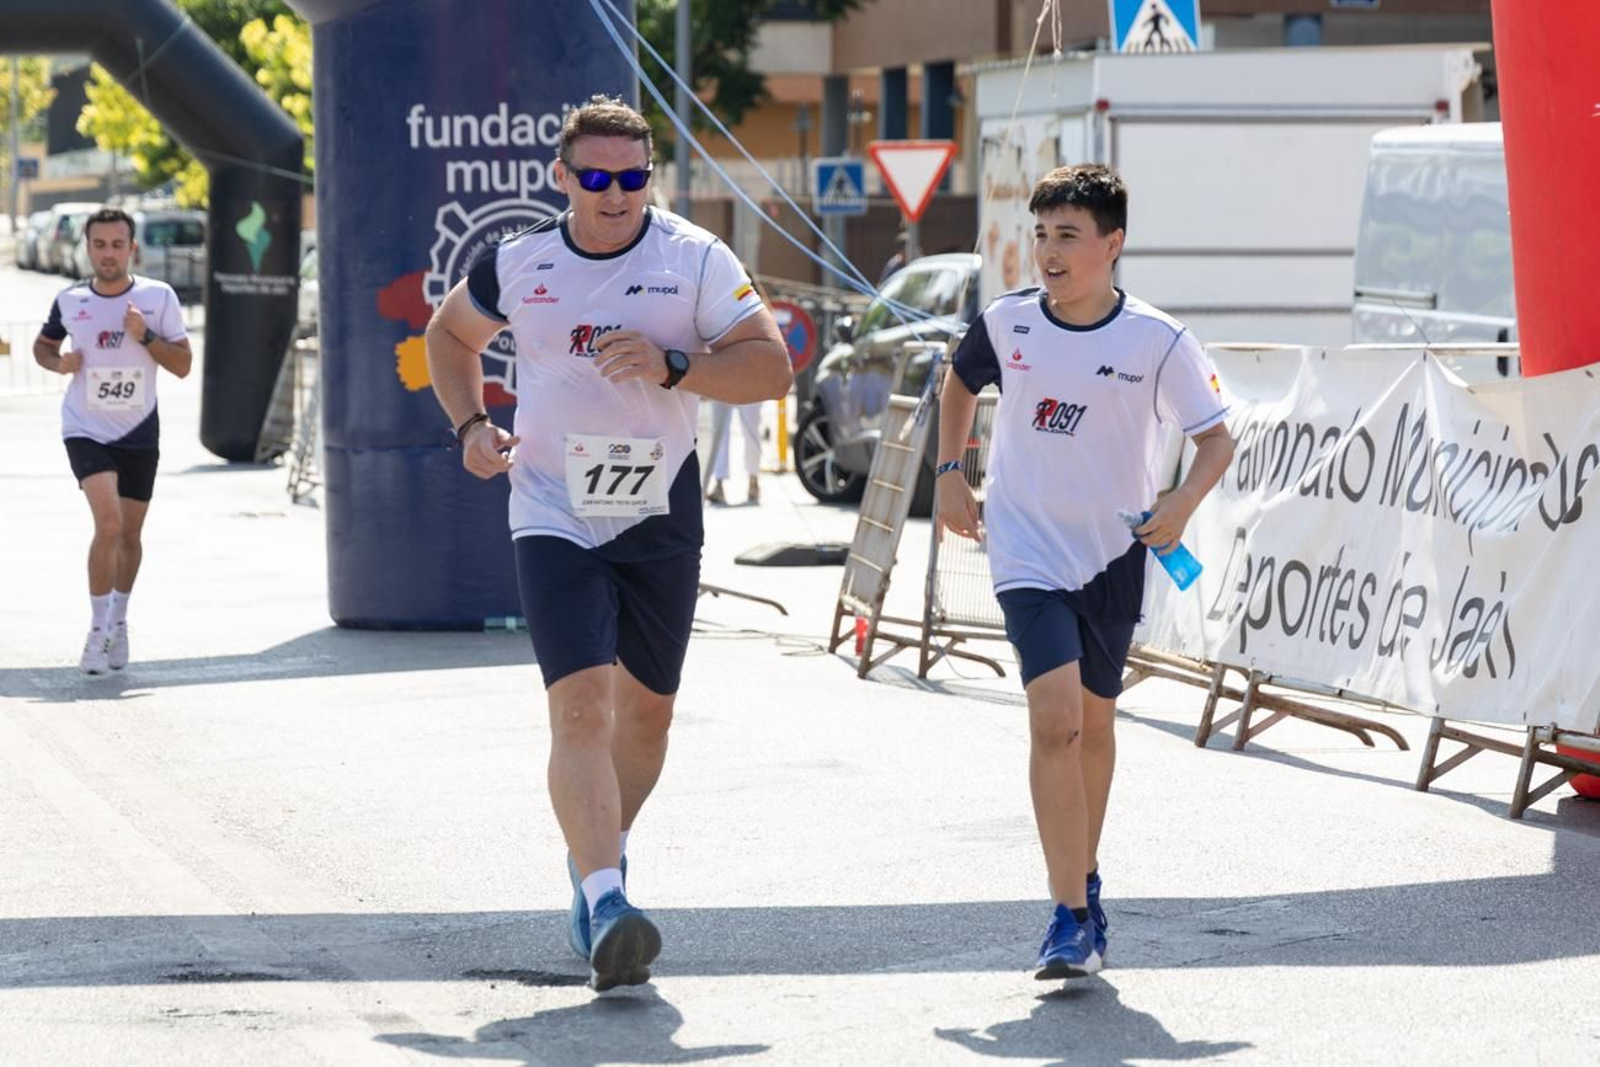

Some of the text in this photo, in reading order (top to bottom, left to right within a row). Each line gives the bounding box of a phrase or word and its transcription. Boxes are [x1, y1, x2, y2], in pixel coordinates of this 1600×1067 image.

[647, 285, 679, 296] mupol
[97, 381, 136, 399] 549
[583, 463, 656, 496] 177
